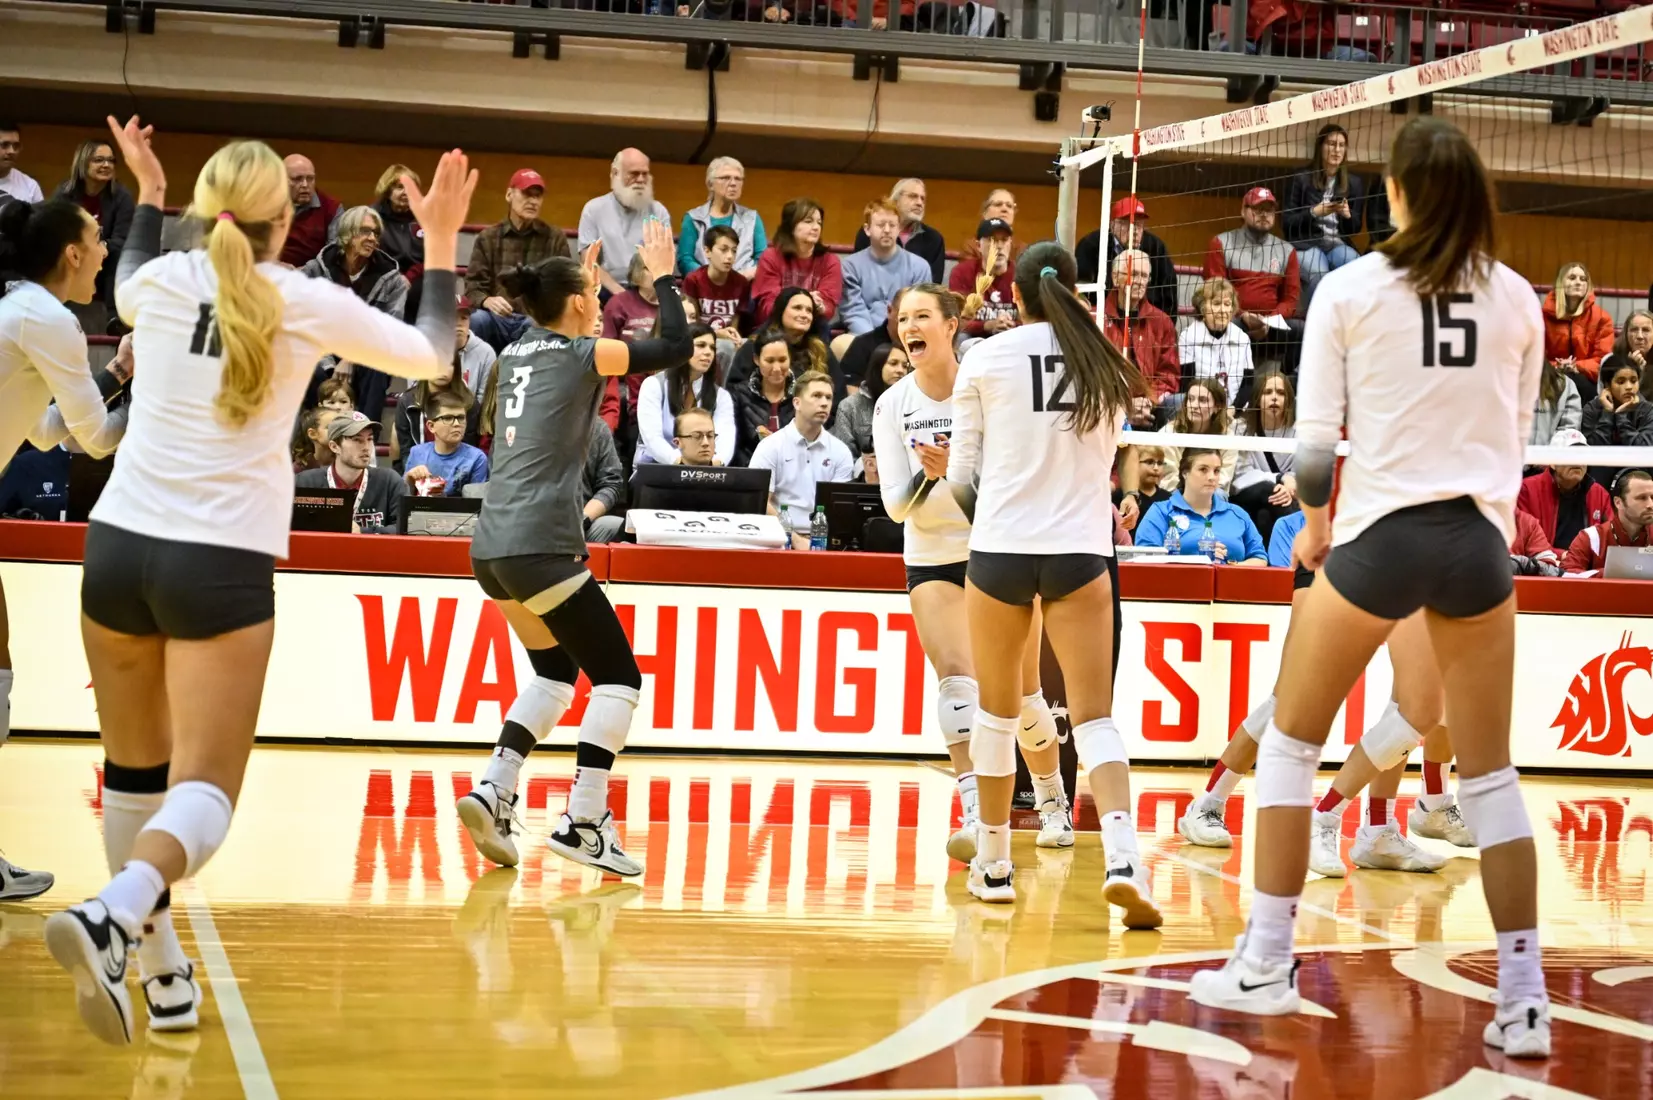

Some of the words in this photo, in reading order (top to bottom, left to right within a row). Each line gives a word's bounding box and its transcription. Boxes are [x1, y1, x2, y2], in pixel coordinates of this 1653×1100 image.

[1543, 24, 1593, 57] WASHINGTON
[1596, 16, 1619, 44] STATE
[1418, 292, 1478, 367] 15
[505, 365, 533, 419] 3
[1027, 354, 1080, 412] 12
